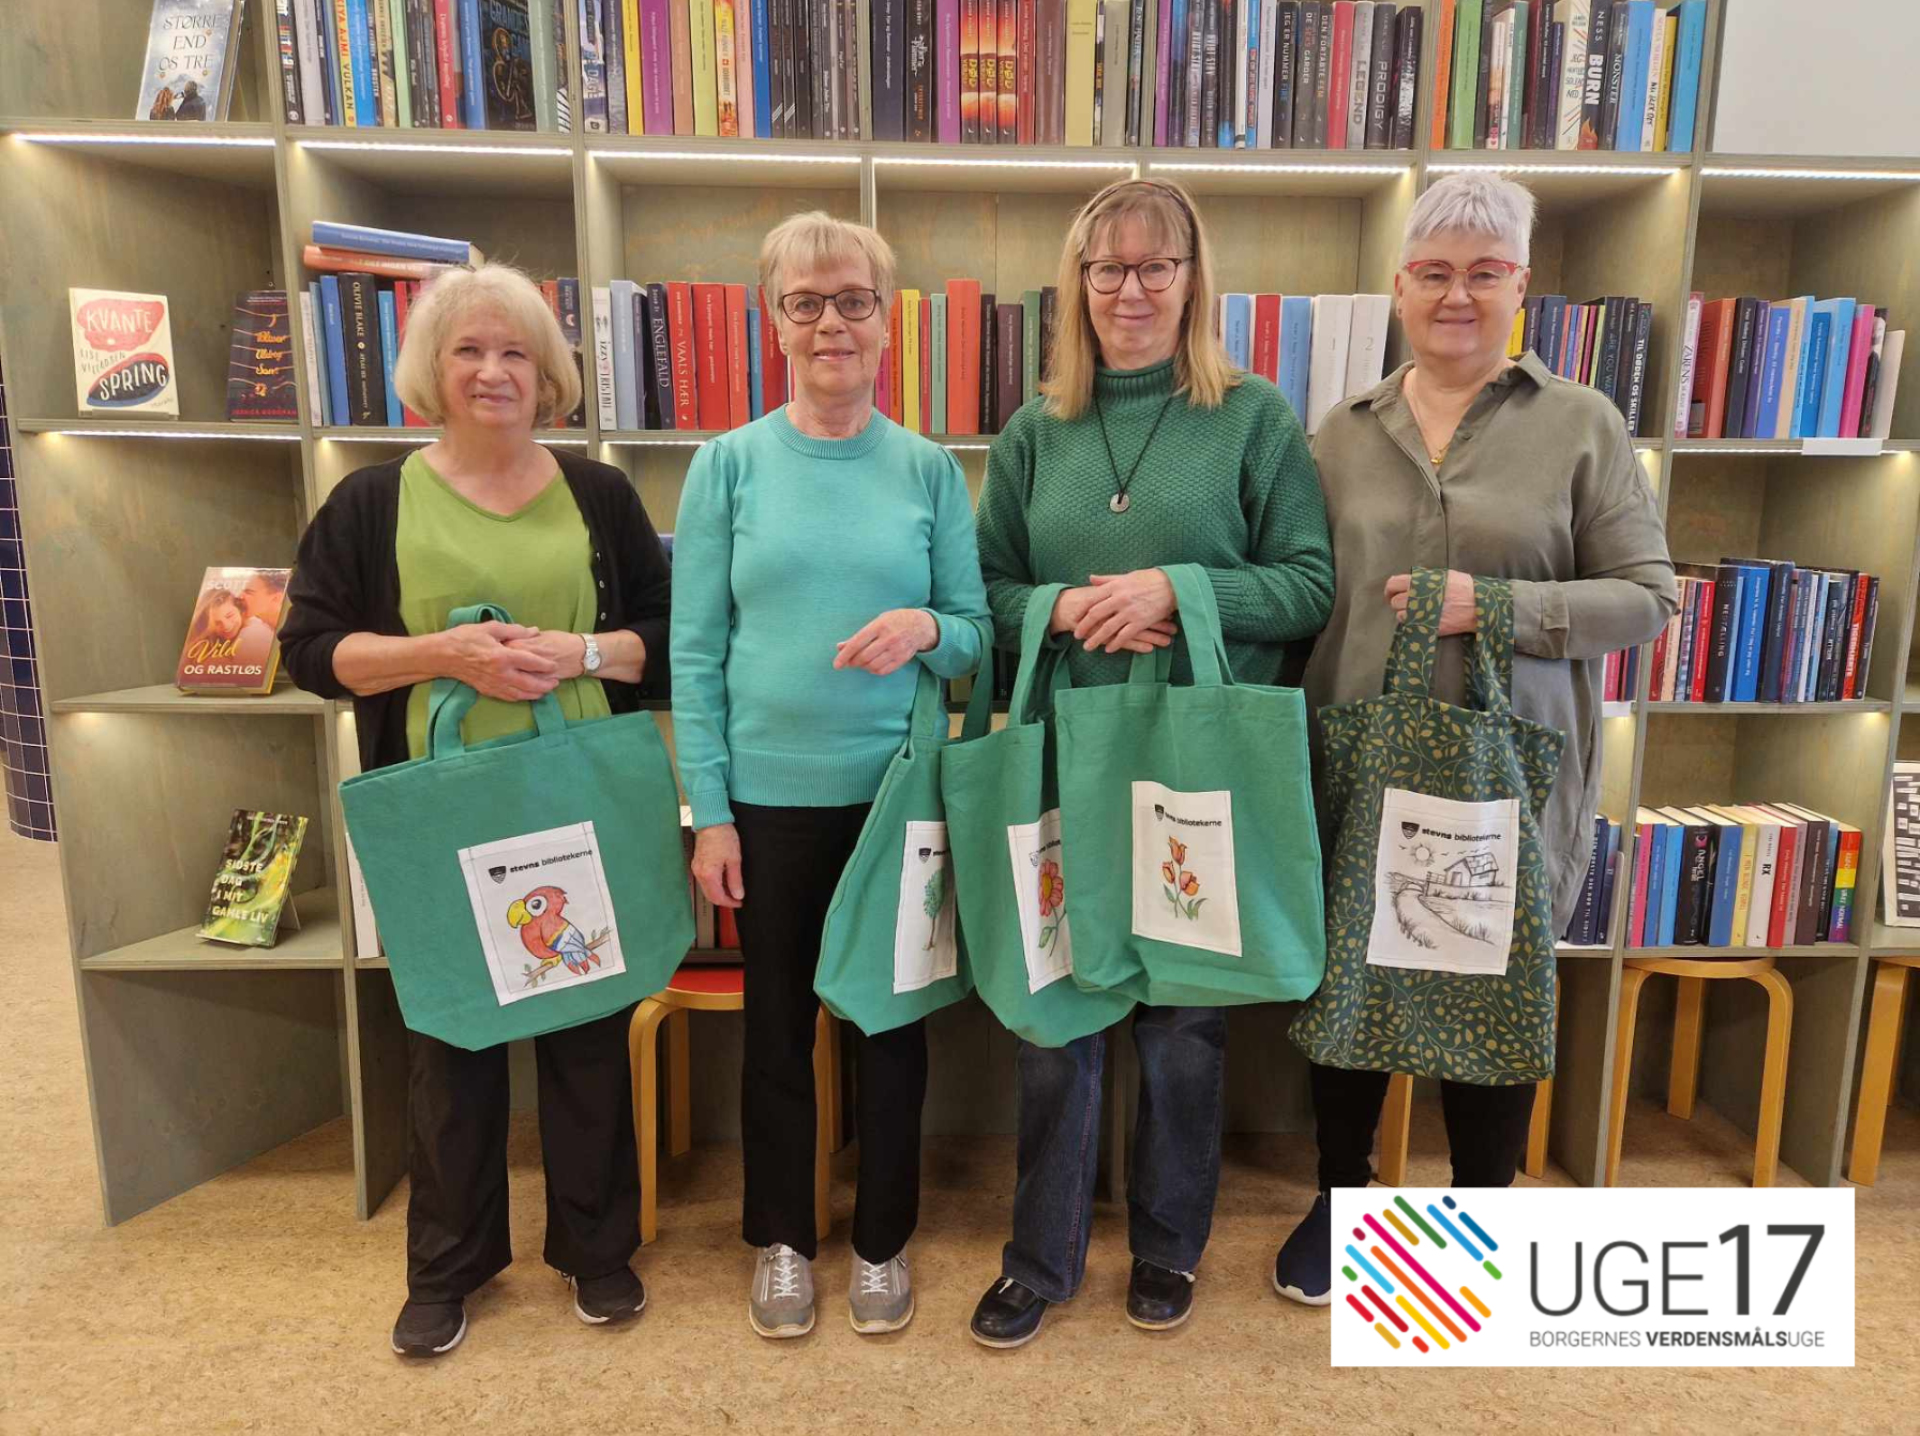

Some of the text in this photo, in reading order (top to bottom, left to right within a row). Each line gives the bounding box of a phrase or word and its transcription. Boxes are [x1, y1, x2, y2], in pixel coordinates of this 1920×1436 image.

[1305, 12, 1313, 24] DE
[1320, 15, 1329, 33] DEN
[1594, 11, 1605, 42] NESS
[173, 35, 207, 50] END
[338, 28, 349, 57] AJMI
[1318, 36, 1328, 78] FORTABTE
[159, 54, 214, 71] OS TRE
[1279, 12, 1292, 103] JEG ER NUMMER FIRE
[343, 63, 354, 110] VULKAN
[968, 59, 978, 88] DØD
[985, 59, 995, 88] DØD
[1004, 61, 1014, 90] DØD
[1584, 54, 1604, 106] BURN
[1609, 53, 1622, 104] MONSTER
[1353, 60, 1367, 126] LEGEND
[1374, 60, 1388, 131] PRODIGY
[353, 281, 364, 310] OLIVIE
[86, 308, 153, 334] KVANTE
[355, 312, 365, 337] BLAKE
[652, 318, 670, 388] ENGLEFALD
[1364, 336, 1375, 352] 2
[1605, 333, 1617, 373] ARE YOU
[676, 340, 690, 408] VAALS HÆR
[1681, 345, 1695, 385] ZARENS
[99, 362, 168, 401] SPRING
[1627, 339, 1645, 432] TIL DØDEN OS SKILLER
[187, 639, 243, 663] Vild
[184, 663, 263, 675] OG RASTLØS
[1422, 828, 1502, 842] stevns bibliotekerne
[225, 859, 264, 873] SIDSTE
[510, 848, 593, 874] stevns bibliotekerne
[1694, 849, 1706, 882] ANGEL
[1761, 863, 1772, 875] RX
[220, 874, 243, 887] DAG
[223, 890, 244, 902] MIT
[212, 905, 270, 923] GAMLE LIV
